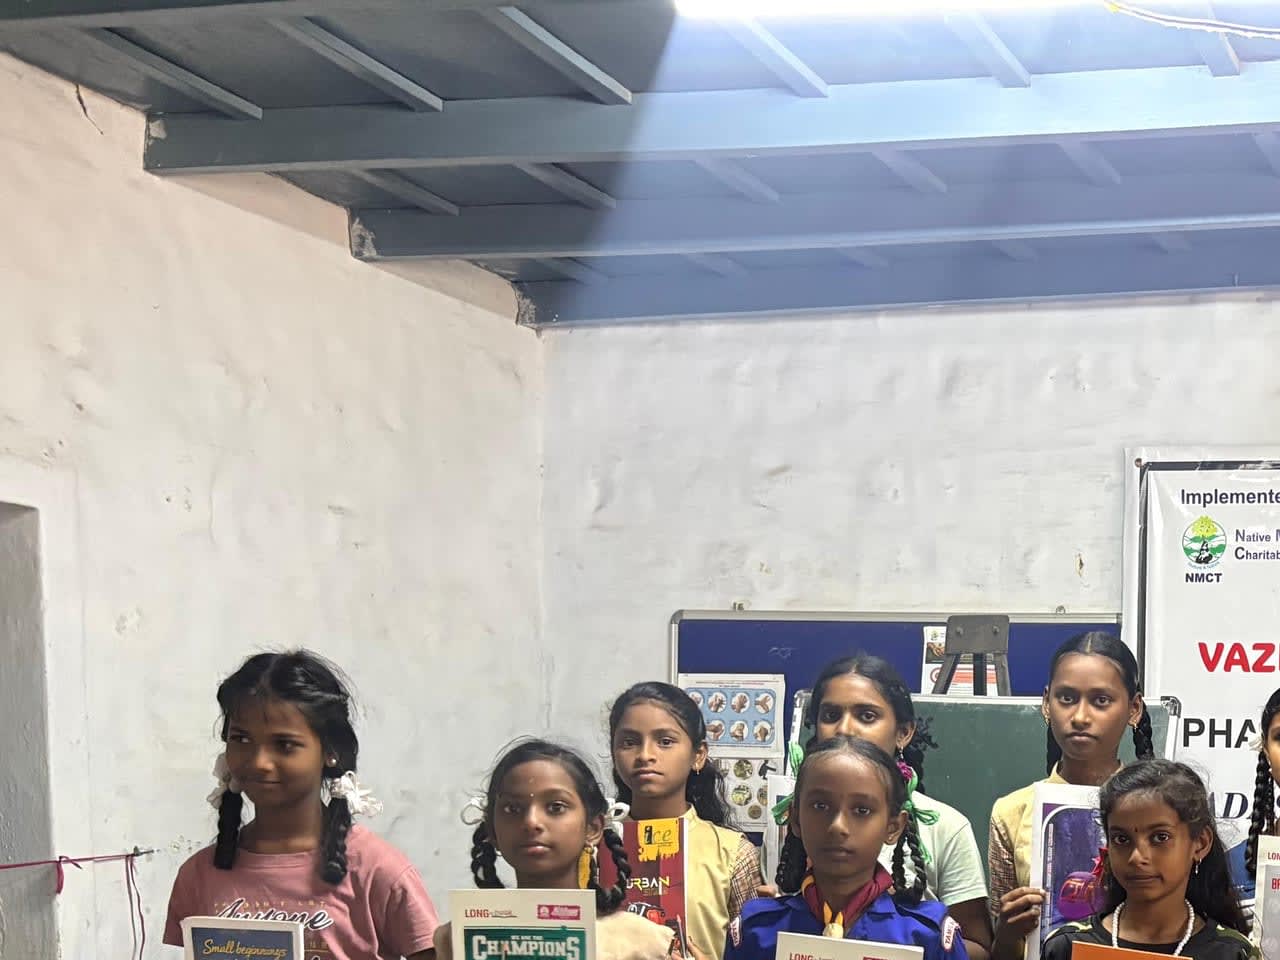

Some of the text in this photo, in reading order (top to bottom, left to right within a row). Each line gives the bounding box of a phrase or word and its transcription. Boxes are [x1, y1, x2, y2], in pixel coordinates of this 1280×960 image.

[1235, 529, 1272, 542] Native
[1185, 572, 1223, 583] NMCT
[1182, 718, 1257, 748] PHA
[626, 876, 671, 895] URBAN
[464, 908, 490, 919] LONG
[203, 938, 235, 955] Small
